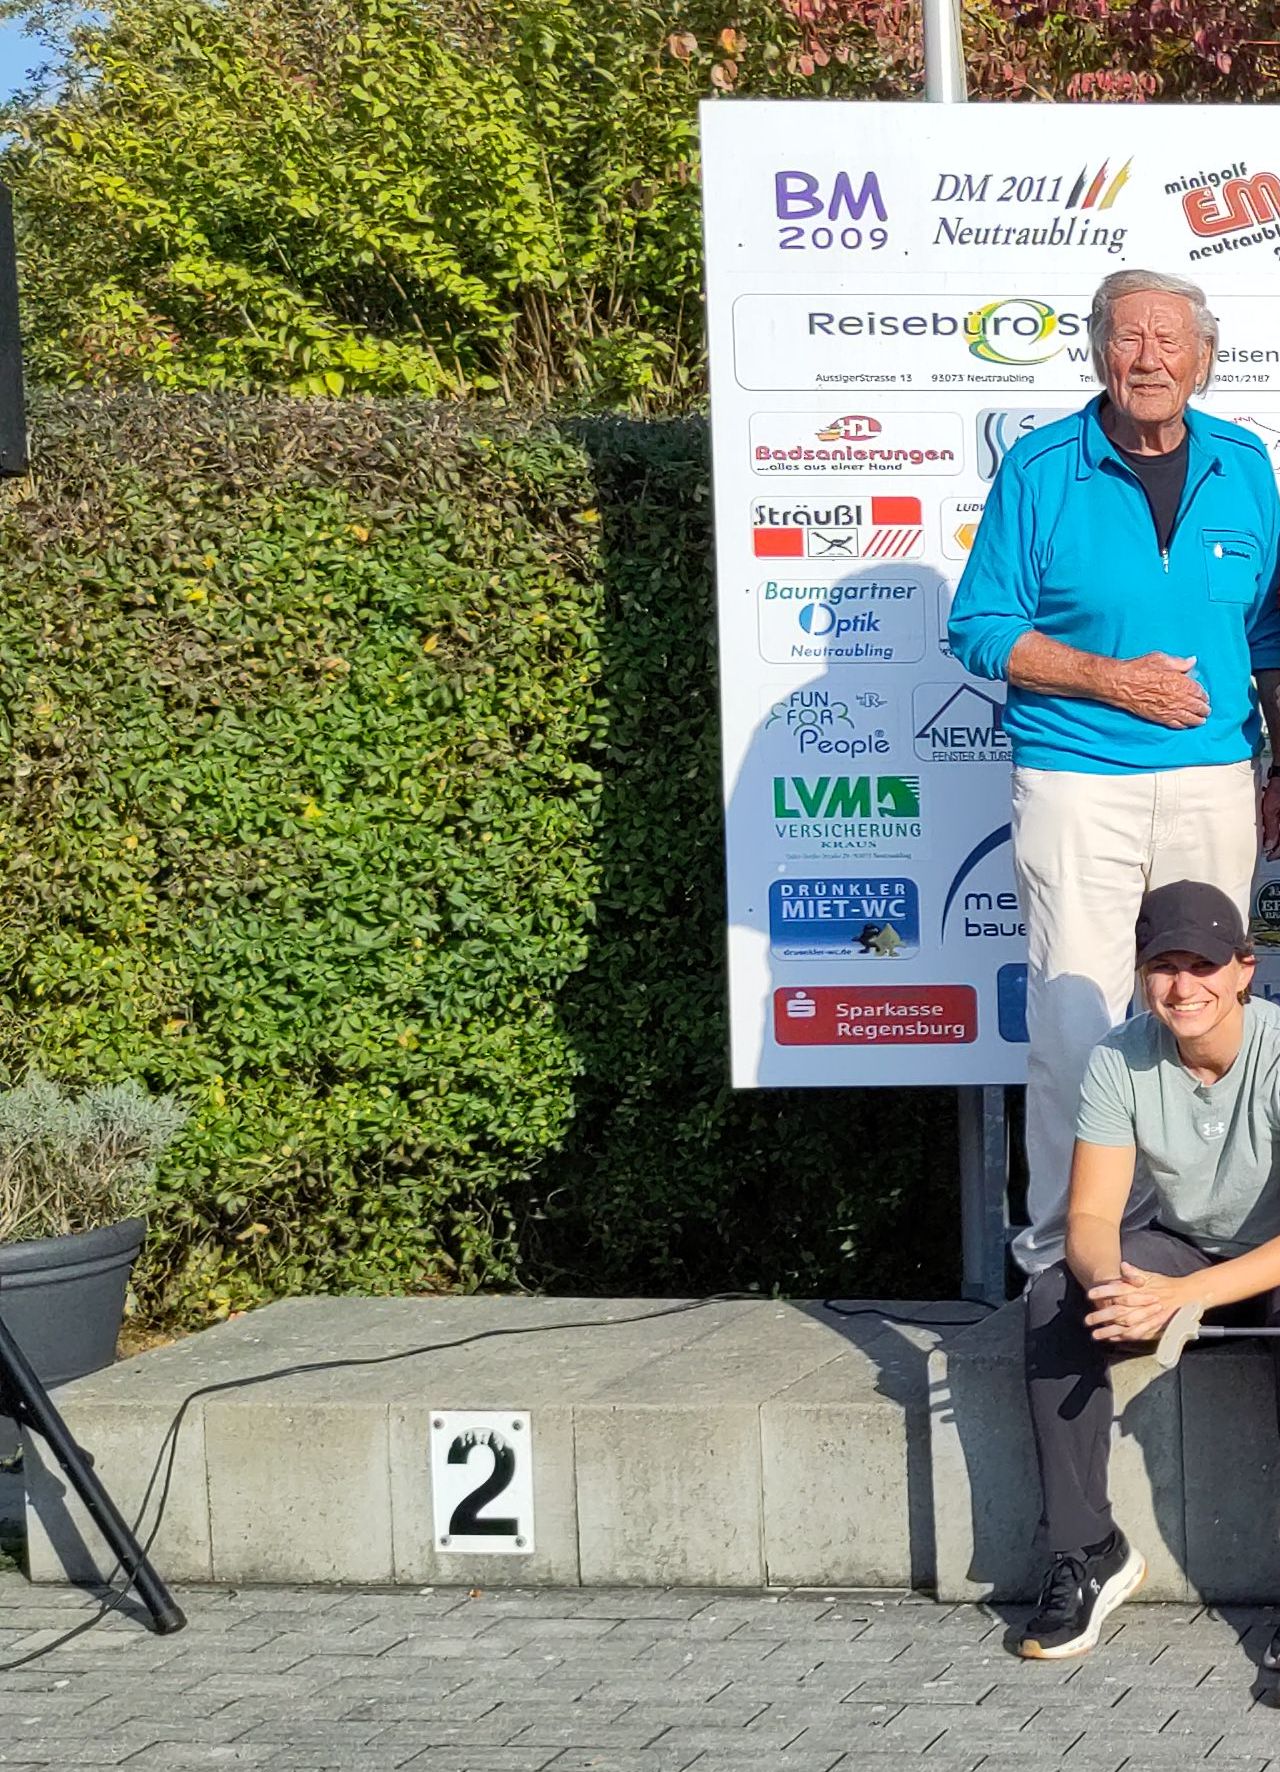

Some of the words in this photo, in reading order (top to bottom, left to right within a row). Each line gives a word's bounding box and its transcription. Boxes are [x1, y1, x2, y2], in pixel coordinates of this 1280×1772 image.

[932, 173, 993, 202] DM
[997, 174, 1064, 202] 2011
[1164, 161, 1248, 195] minigolf
[775, 170, 888, 222] BM
[778, 226, 888, 250] 2009
[933, 217, 1128, 254] Neutraubling
[808, 310, 1040, 336] Reisebüro
[900, 373, 913, 382] 13
[931, 373, 964, 382] 93073
[966, 372, 1035, 383] Neutraubling
[1214, 374, 1270, 383] 9401/2187
[755, 445, 955, 465] Badsanierungen
[831, 463, 865, 471] einer
[868, 463, 903, 471] Hand
[753, 504, 863, 527] Sträußl
[765, 582, 917, 606] Baumgartner
[799, 602, 881, 638] Optik
[791, 644, 894, 660] Neutraubling
[790, 691, 829, 708] FUN
[787, 709, 833, 726] FOR
[800, 729, 891, 759] People
[932, 751, 975, 761] FENSTER
[773, 776, 871, 818] LVM
[775, 823, 922, 838] VERSICHERUNG
[821, 841, 877, 849] KRAUS
[781, 882, 906, 897] DRÜNKLER
[782, 898, 907, 919] MIET-WC
[836, 1003, 944, 1019] Sparkasse
[837, 1022, 965, 1039] Regensburg
[447, 1427, 519, 1536] 2
